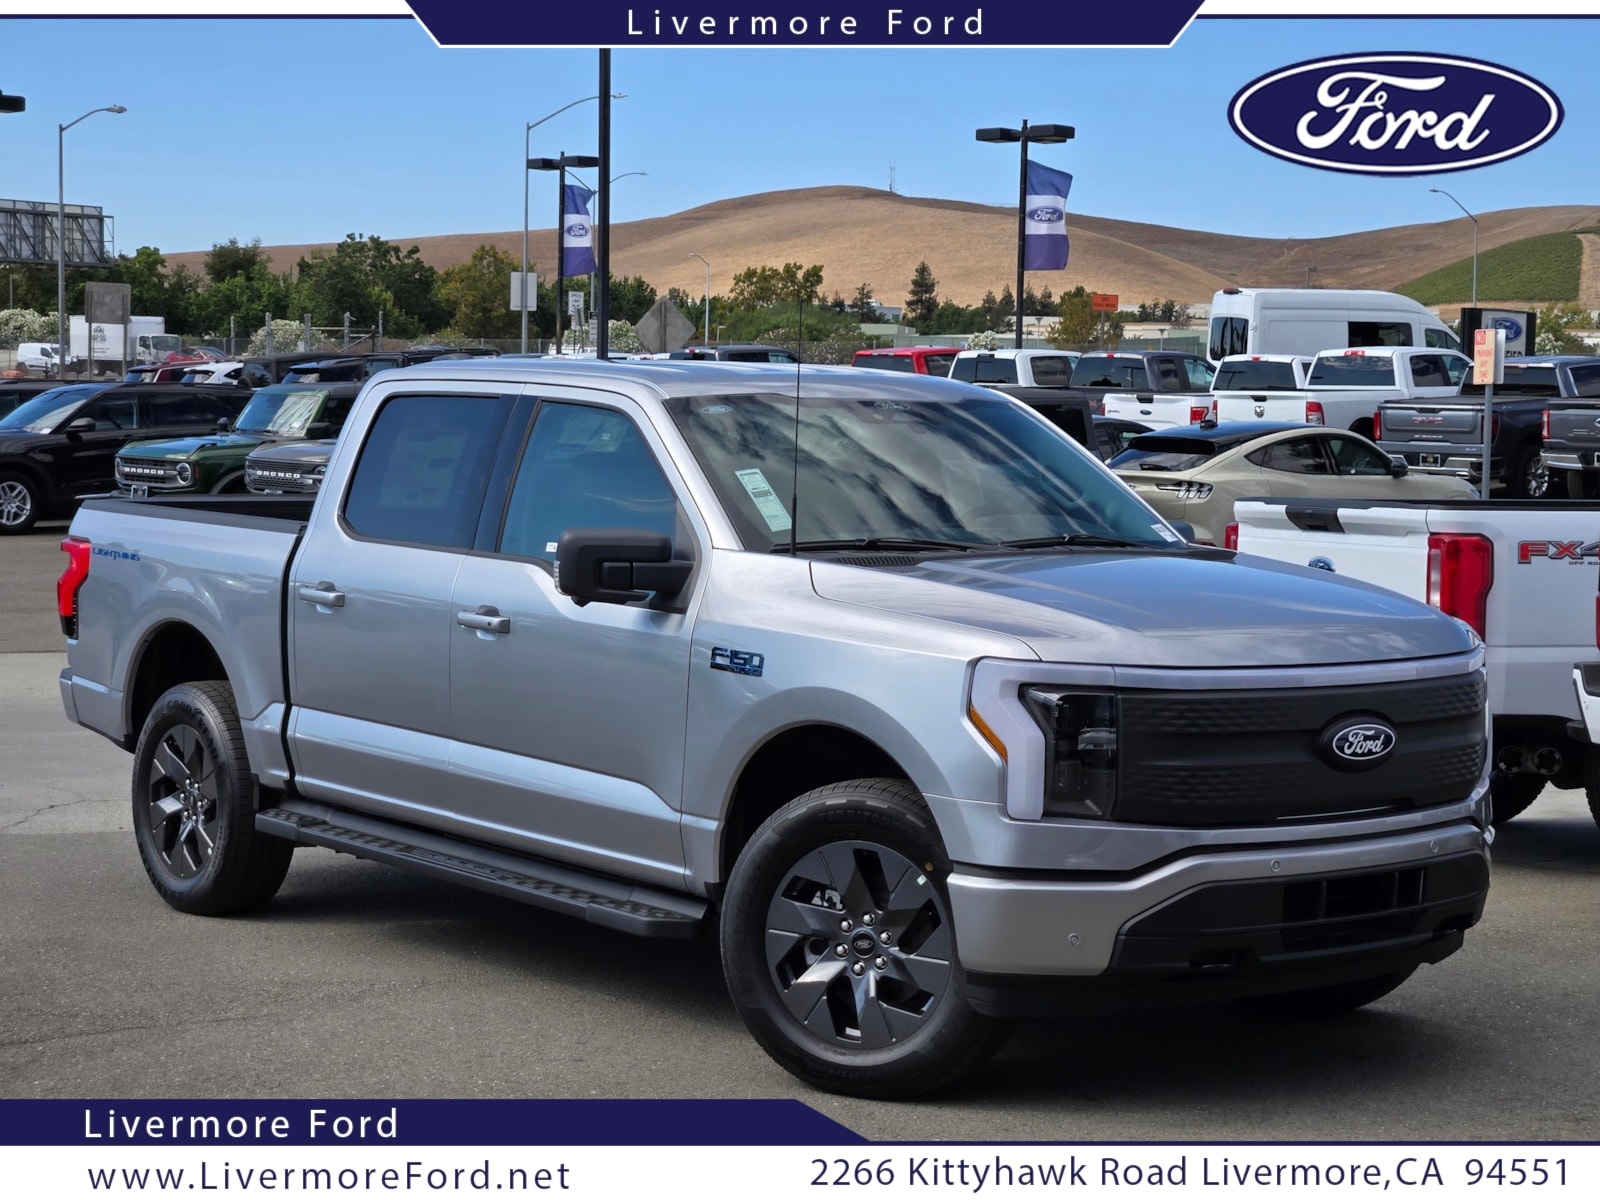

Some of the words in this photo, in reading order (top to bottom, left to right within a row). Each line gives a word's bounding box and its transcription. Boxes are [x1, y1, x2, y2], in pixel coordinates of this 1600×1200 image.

[1034, 208, 1060, 221] Ford
[1476, 332, 1485, 344] NO
[124, 467, 165, 475] BRONCO
[256, 470, 301, 479] BRONCO
[1518, 540, 1599, 564] FX4
[166, 699, 219, 761] GOODYEAR
[1344, 729, 1385, 755] Ford
[817, 809, 901, 827] TERRITORY
